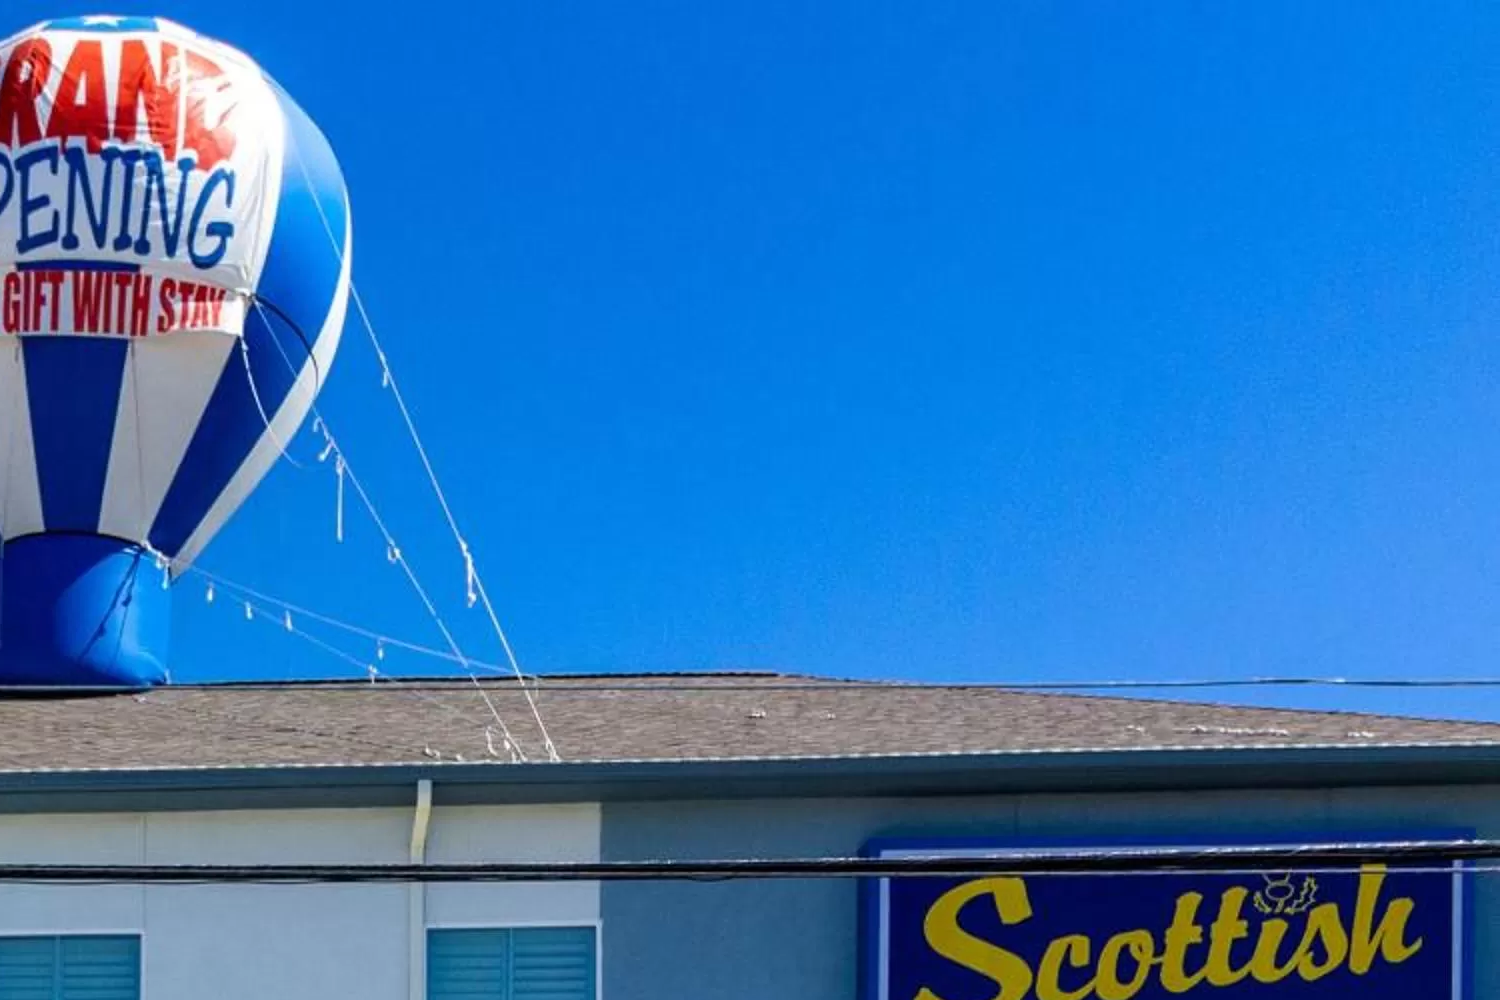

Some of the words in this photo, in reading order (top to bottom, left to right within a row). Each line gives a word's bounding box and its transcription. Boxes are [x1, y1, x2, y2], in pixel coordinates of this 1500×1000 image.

[3, 270, 65, 336] GIFT
[72, 270, 151, 337] WITH
[158, 278, 225, 333] STAY
